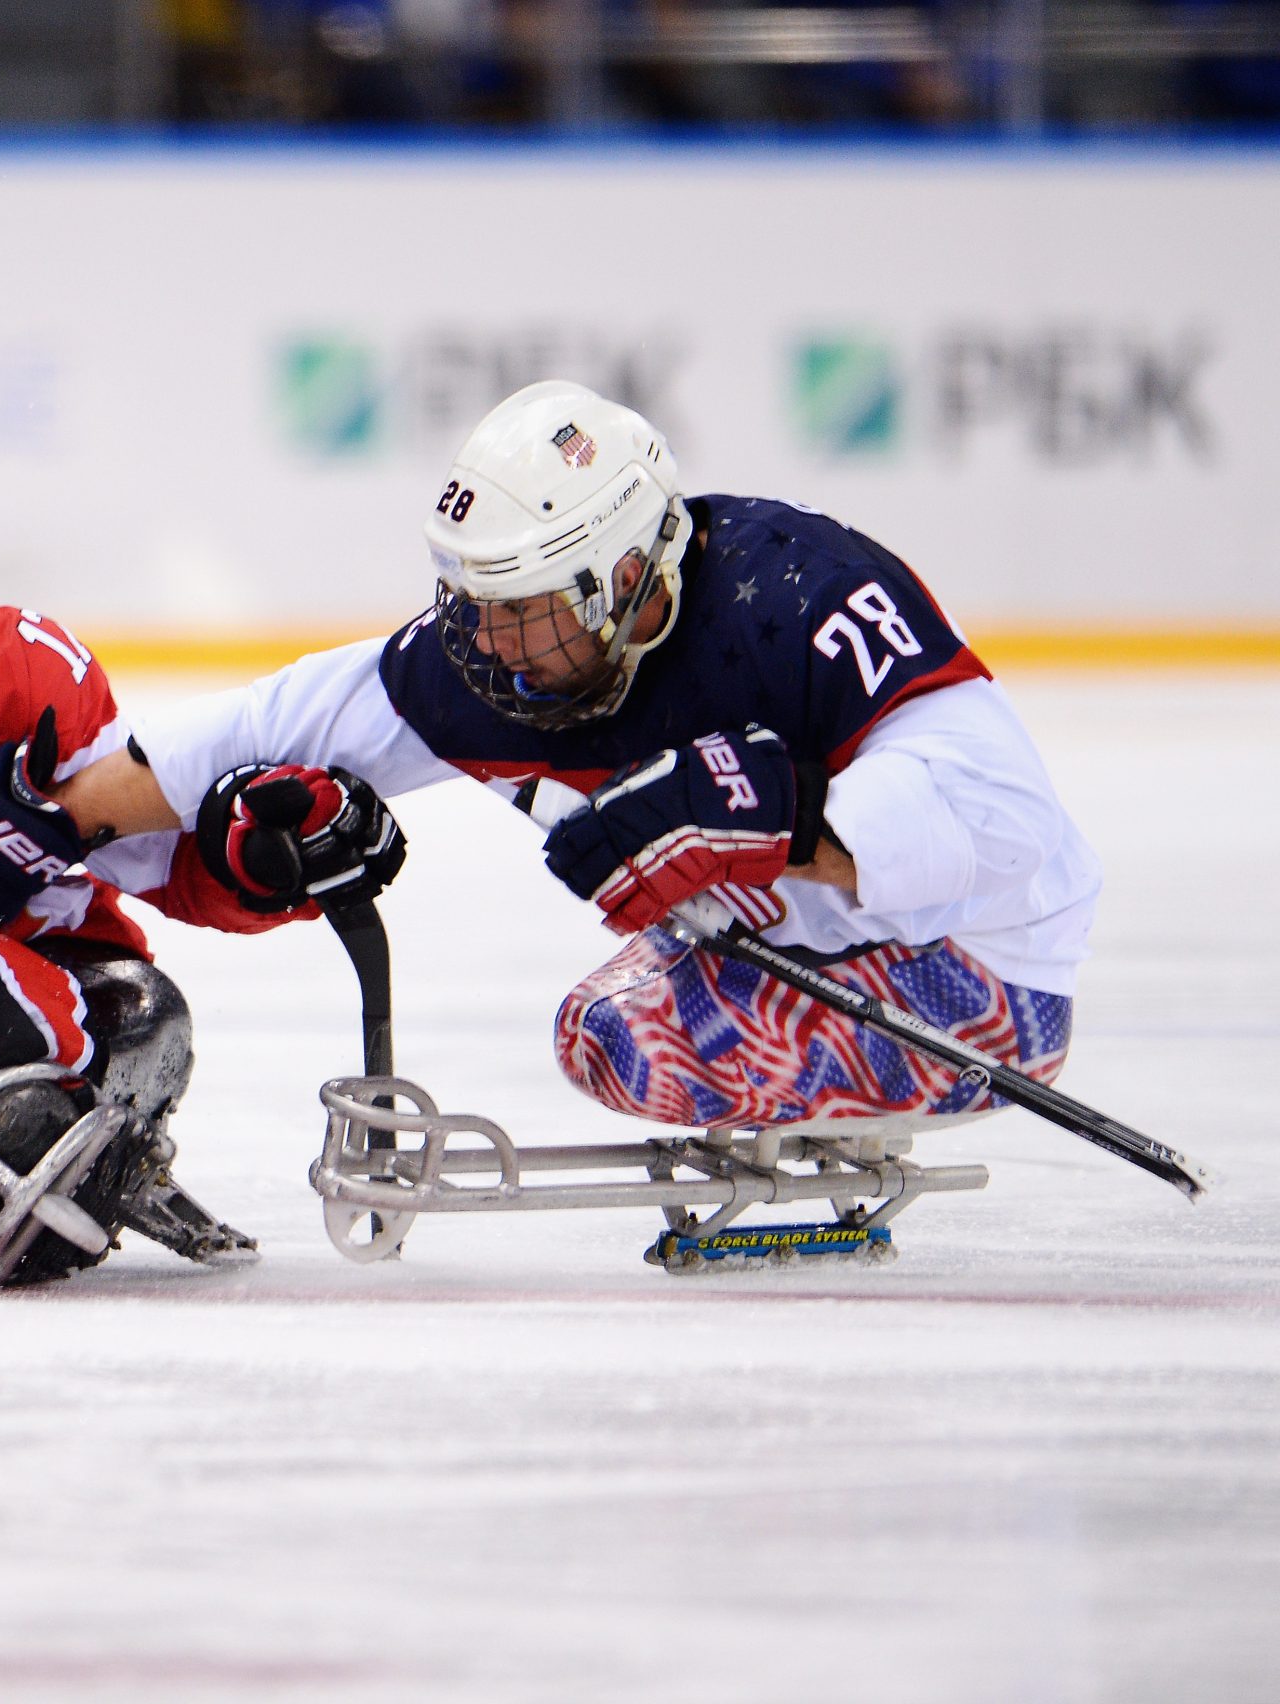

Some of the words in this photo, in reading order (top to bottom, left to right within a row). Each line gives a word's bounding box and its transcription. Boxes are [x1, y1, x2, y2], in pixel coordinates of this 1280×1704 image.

[435, 480, 476, 523] 28
[812, 580, 923, 698] 28
[713, 1234, 759, 1249] FORCE
[762, 1232, 812, 1247] BLADE
[814, 1229, 869, 1244] SYSTEM
